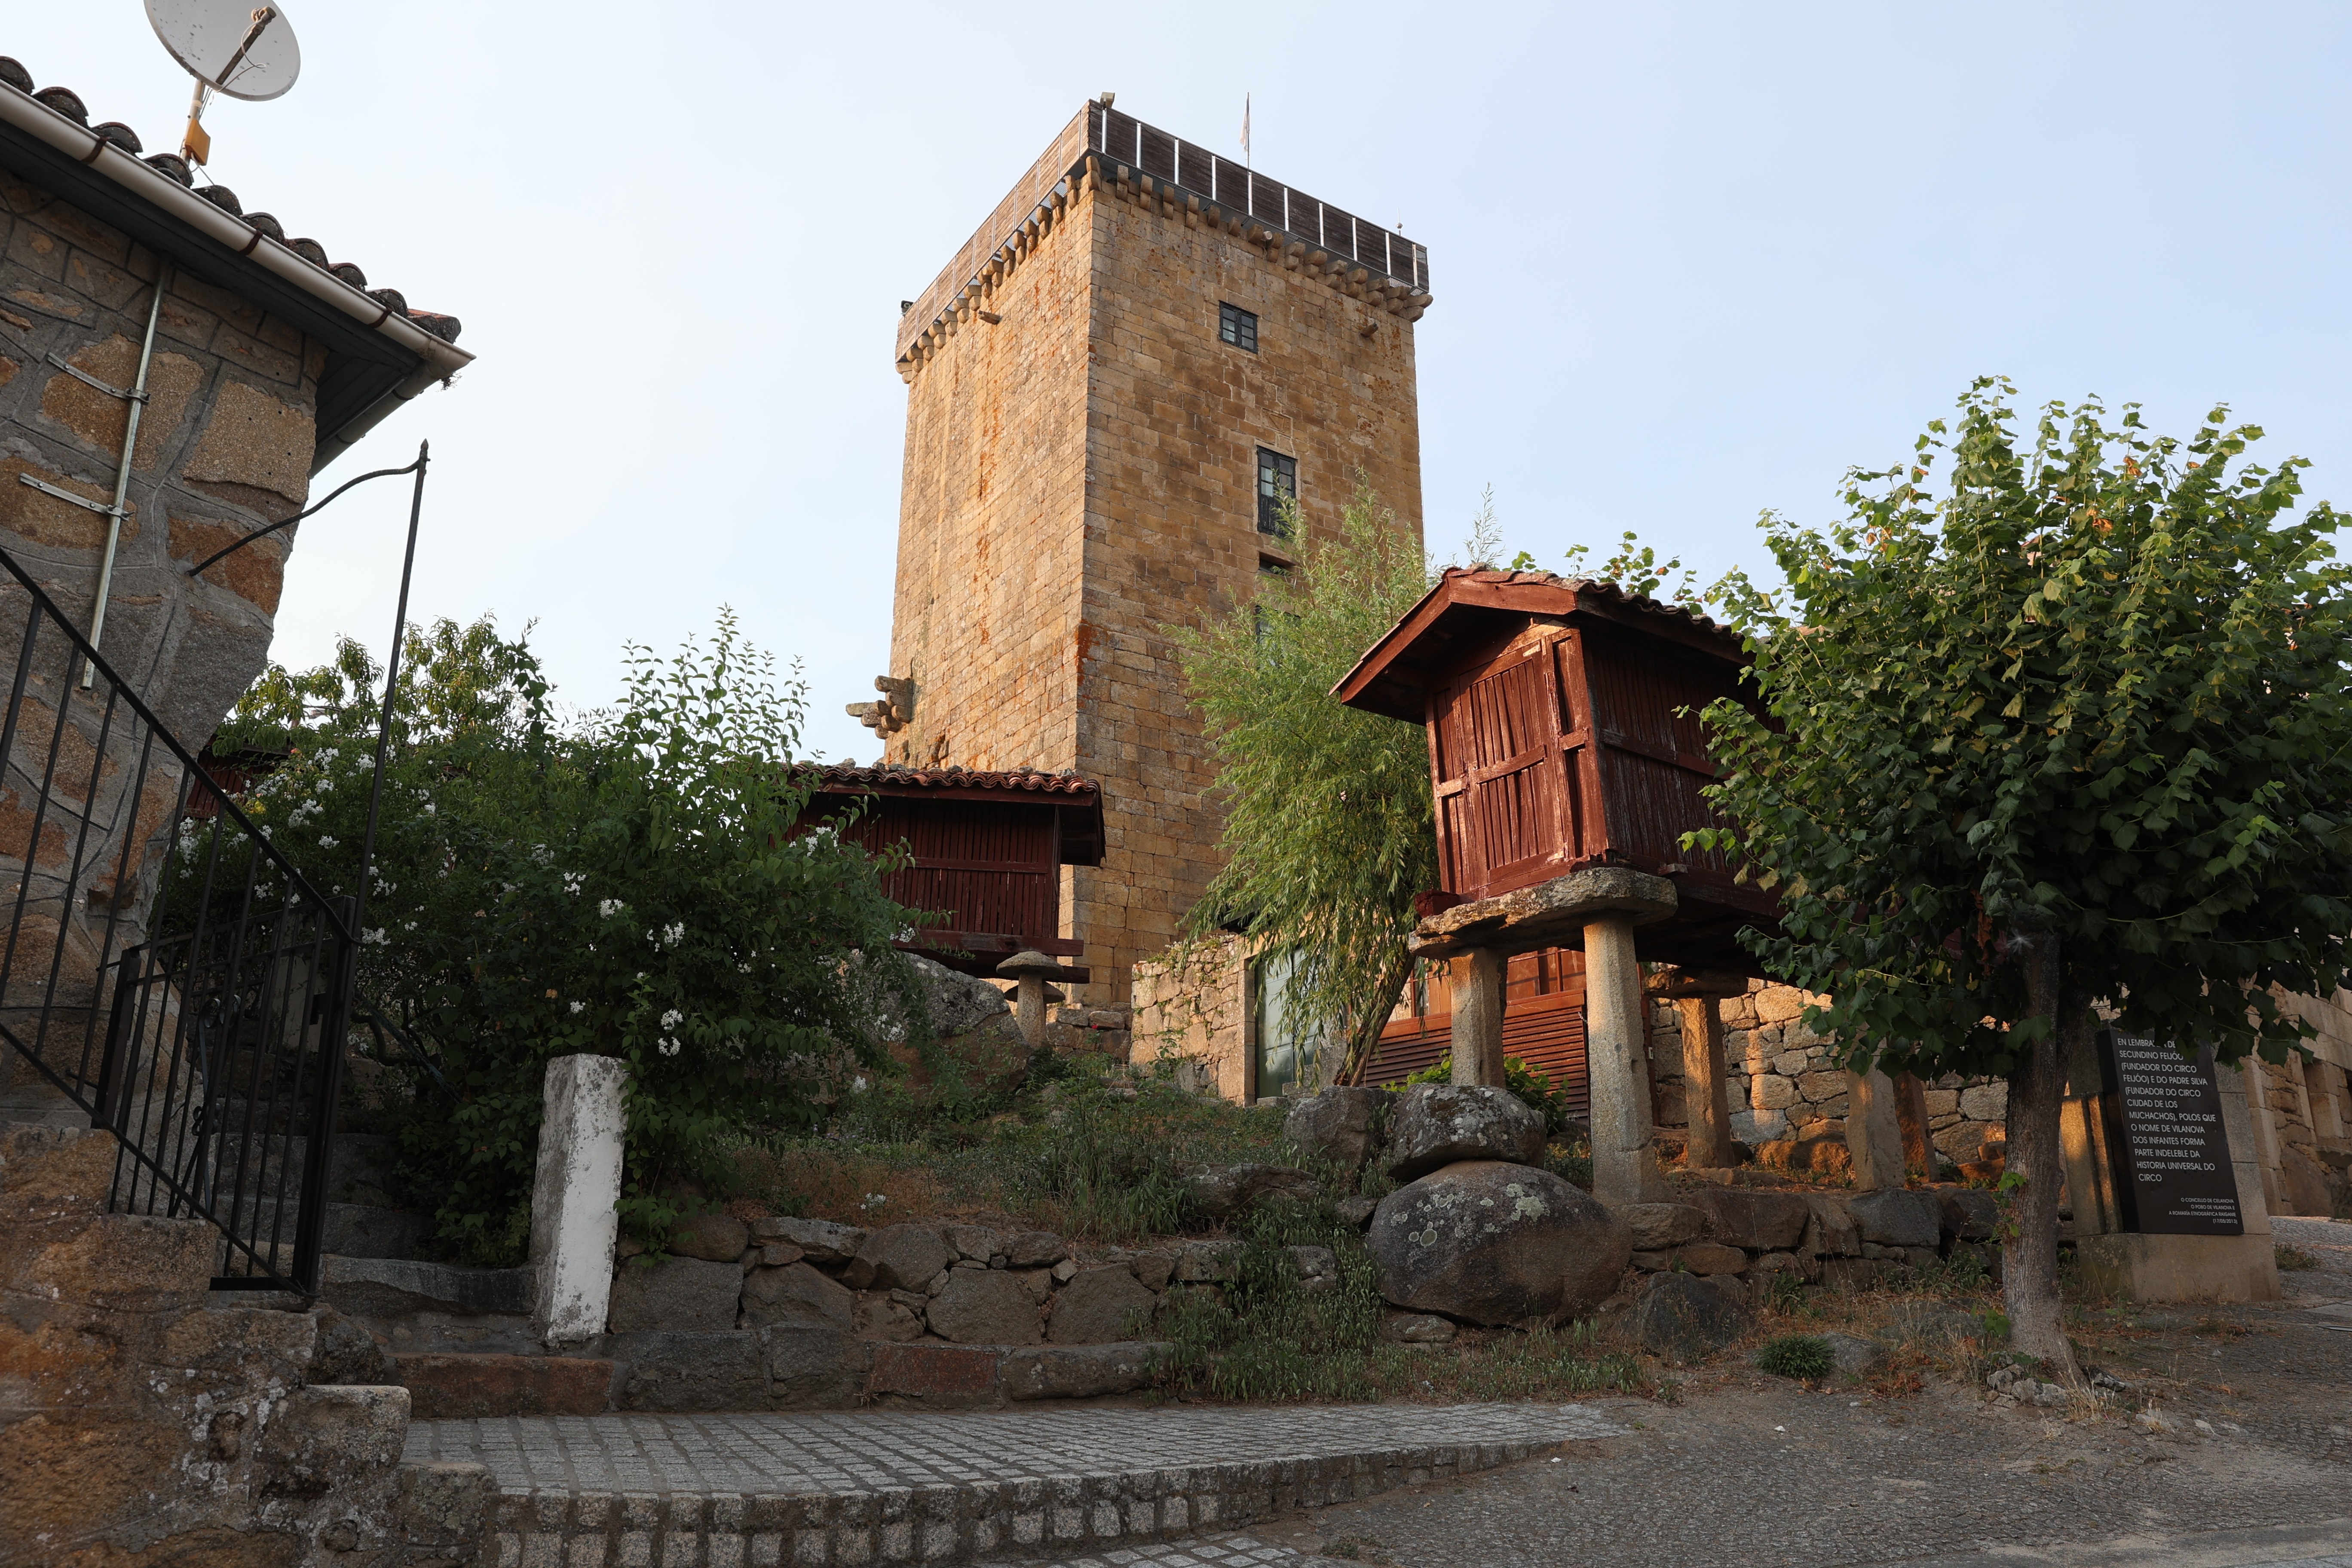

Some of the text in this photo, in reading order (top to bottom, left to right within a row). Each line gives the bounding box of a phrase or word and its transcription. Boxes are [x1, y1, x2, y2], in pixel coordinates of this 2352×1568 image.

[2128, 1039, 2167, 1047] LEMBRA
[2119, 1050, 2159, 1059] SECUNDINO
[2122, 1063, 2160, 1071] (FUNDADOR
[2174, 1065, 2196, 1073] CIRCO
[2123, 1073, 2149, 1084] FEIJÓO)
[2125, 1087, 2164, 1095] (FUNDADOR
[2127, 1099, 2153, 1107] CIUDAD
[2129, 1112, 2177, 1121] MUCHACHOS),
[2171, 1125, 2205, 1133] VILANOVA
[2150, 1137, 2179, 1145] INFANTES
[2156, 1149, 2188, 1158] INDELEBLE
[2168, 1162, 2202, 1170] UNIVERSAL
